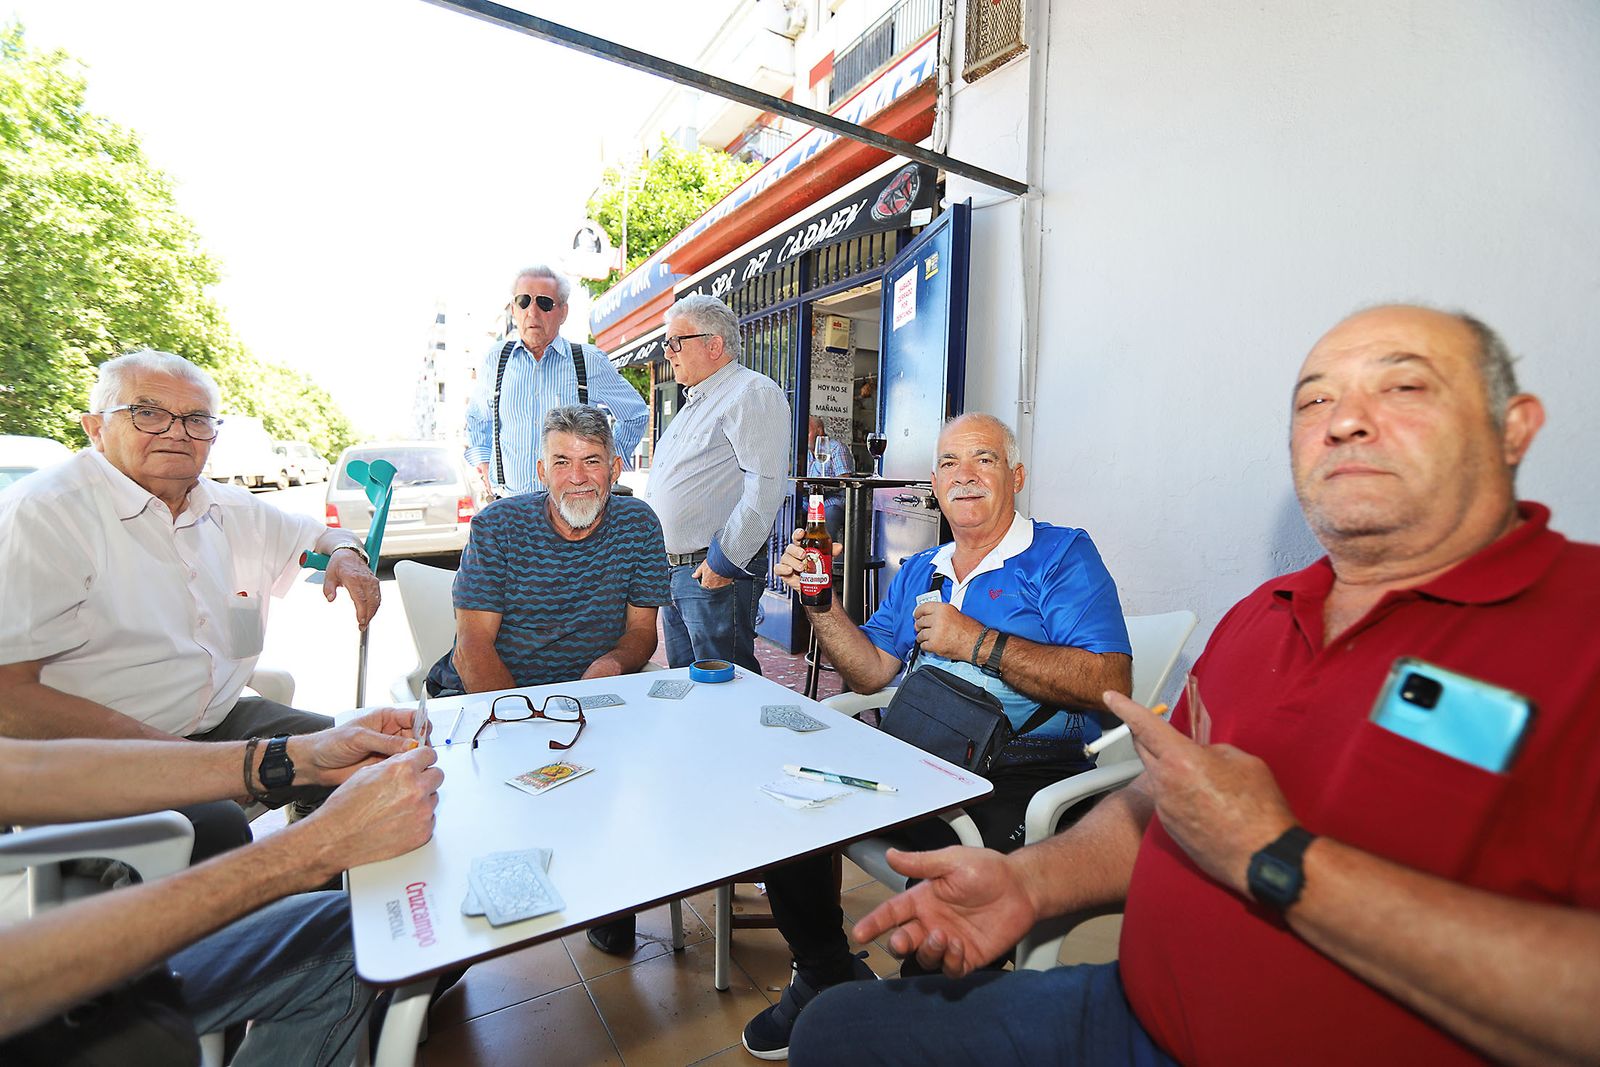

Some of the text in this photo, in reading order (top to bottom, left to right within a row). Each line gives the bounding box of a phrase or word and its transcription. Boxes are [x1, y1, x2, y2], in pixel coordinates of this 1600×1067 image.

[776, 198, 869, 264] CARMEN
[831, 385, 840, 393] NO
[815, 404, 842, 413] MAÑANA
[405, 881, 436, 948] Cruzcampo
